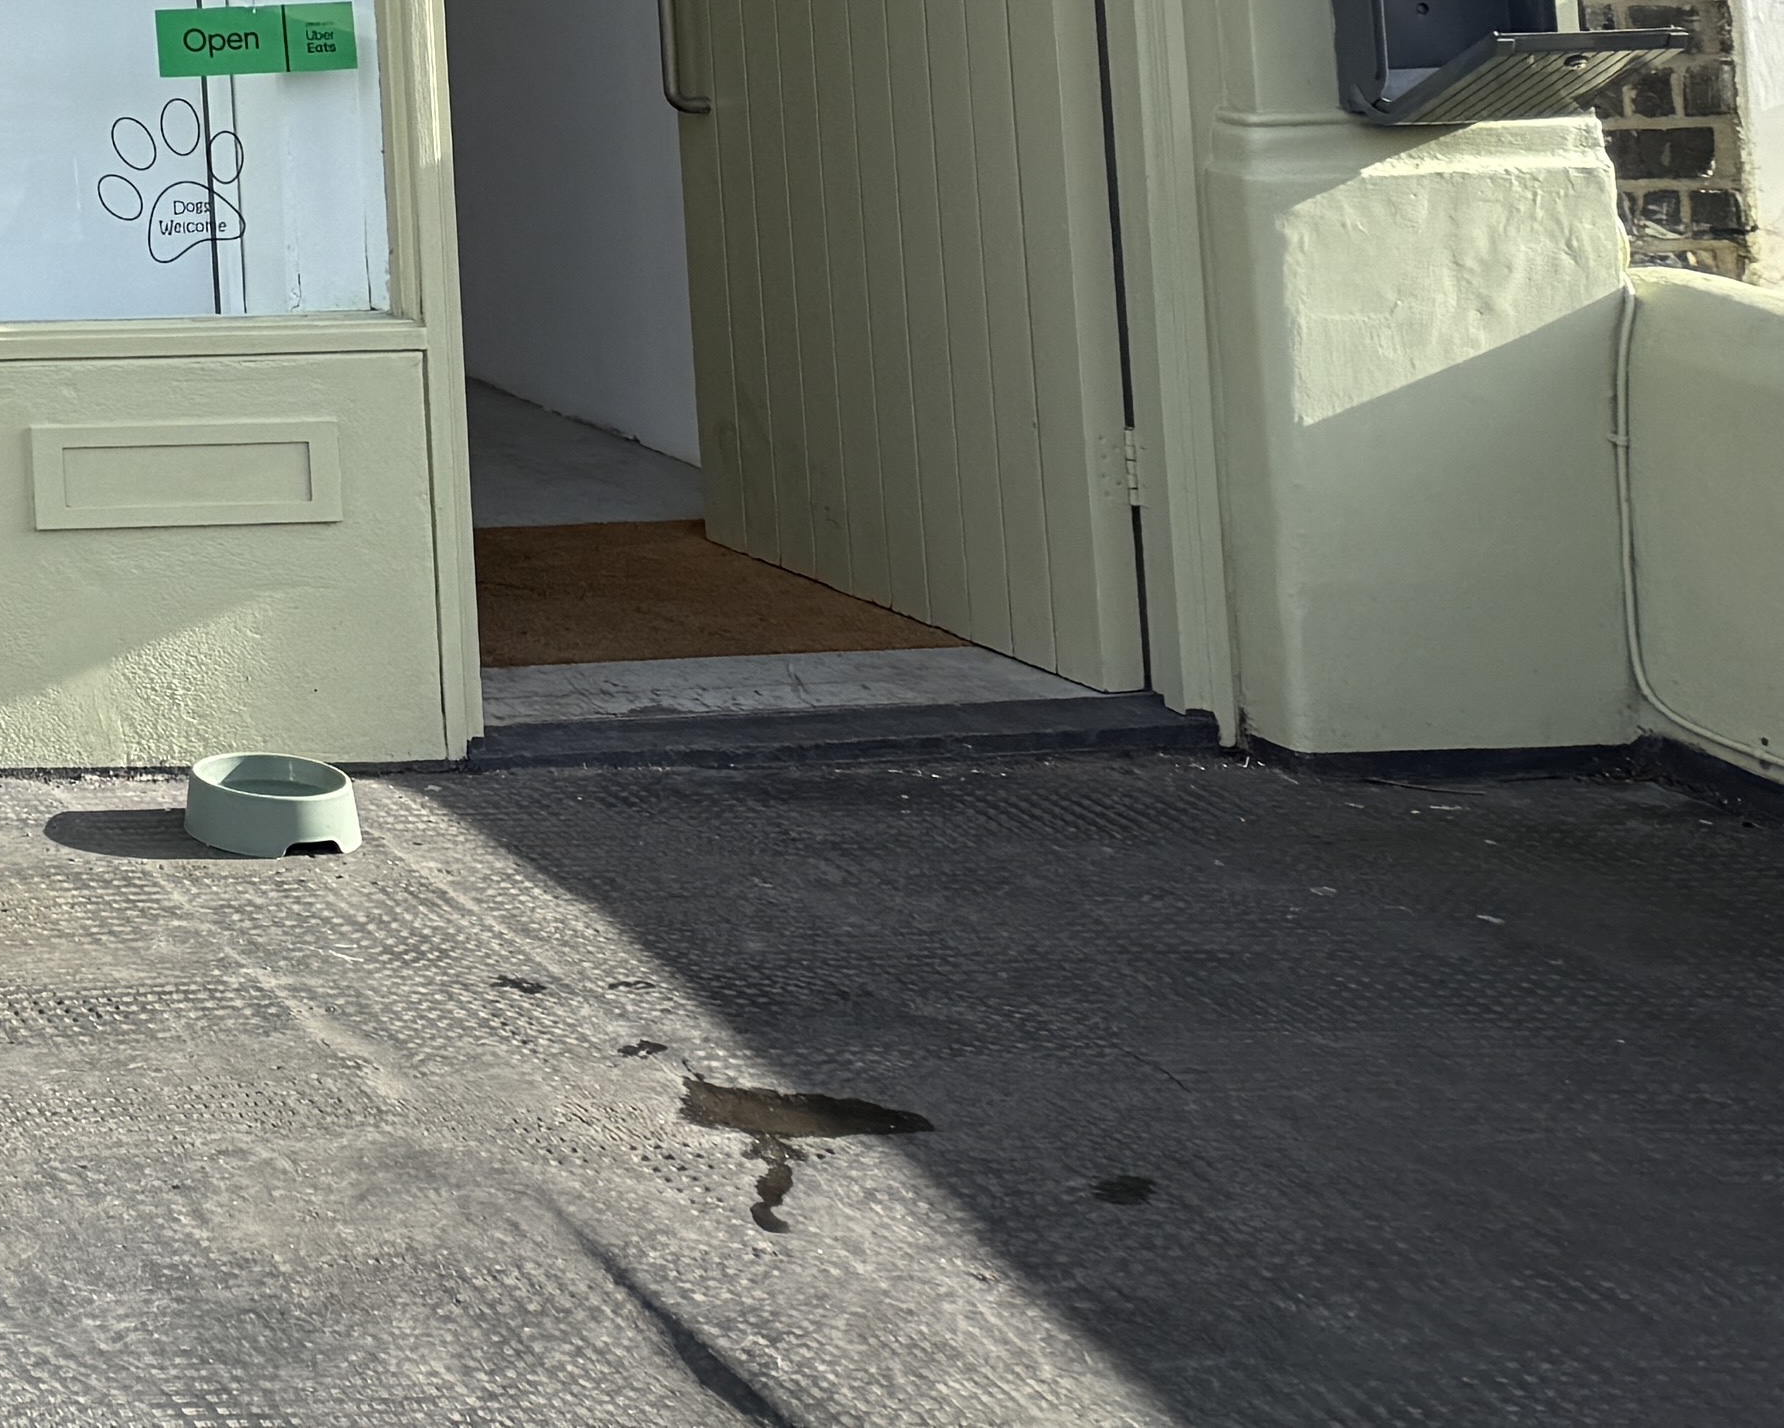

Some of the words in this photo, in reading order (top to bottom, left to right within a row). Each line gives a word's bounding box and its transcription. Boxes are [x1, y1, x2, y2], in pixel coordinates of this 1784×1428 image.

[182, 27, 260, 58] Open
[305, 30, 334, 41] Uber
[306, 42, 337, 54] Eats
[173, 200, 211, 216] Dogs
